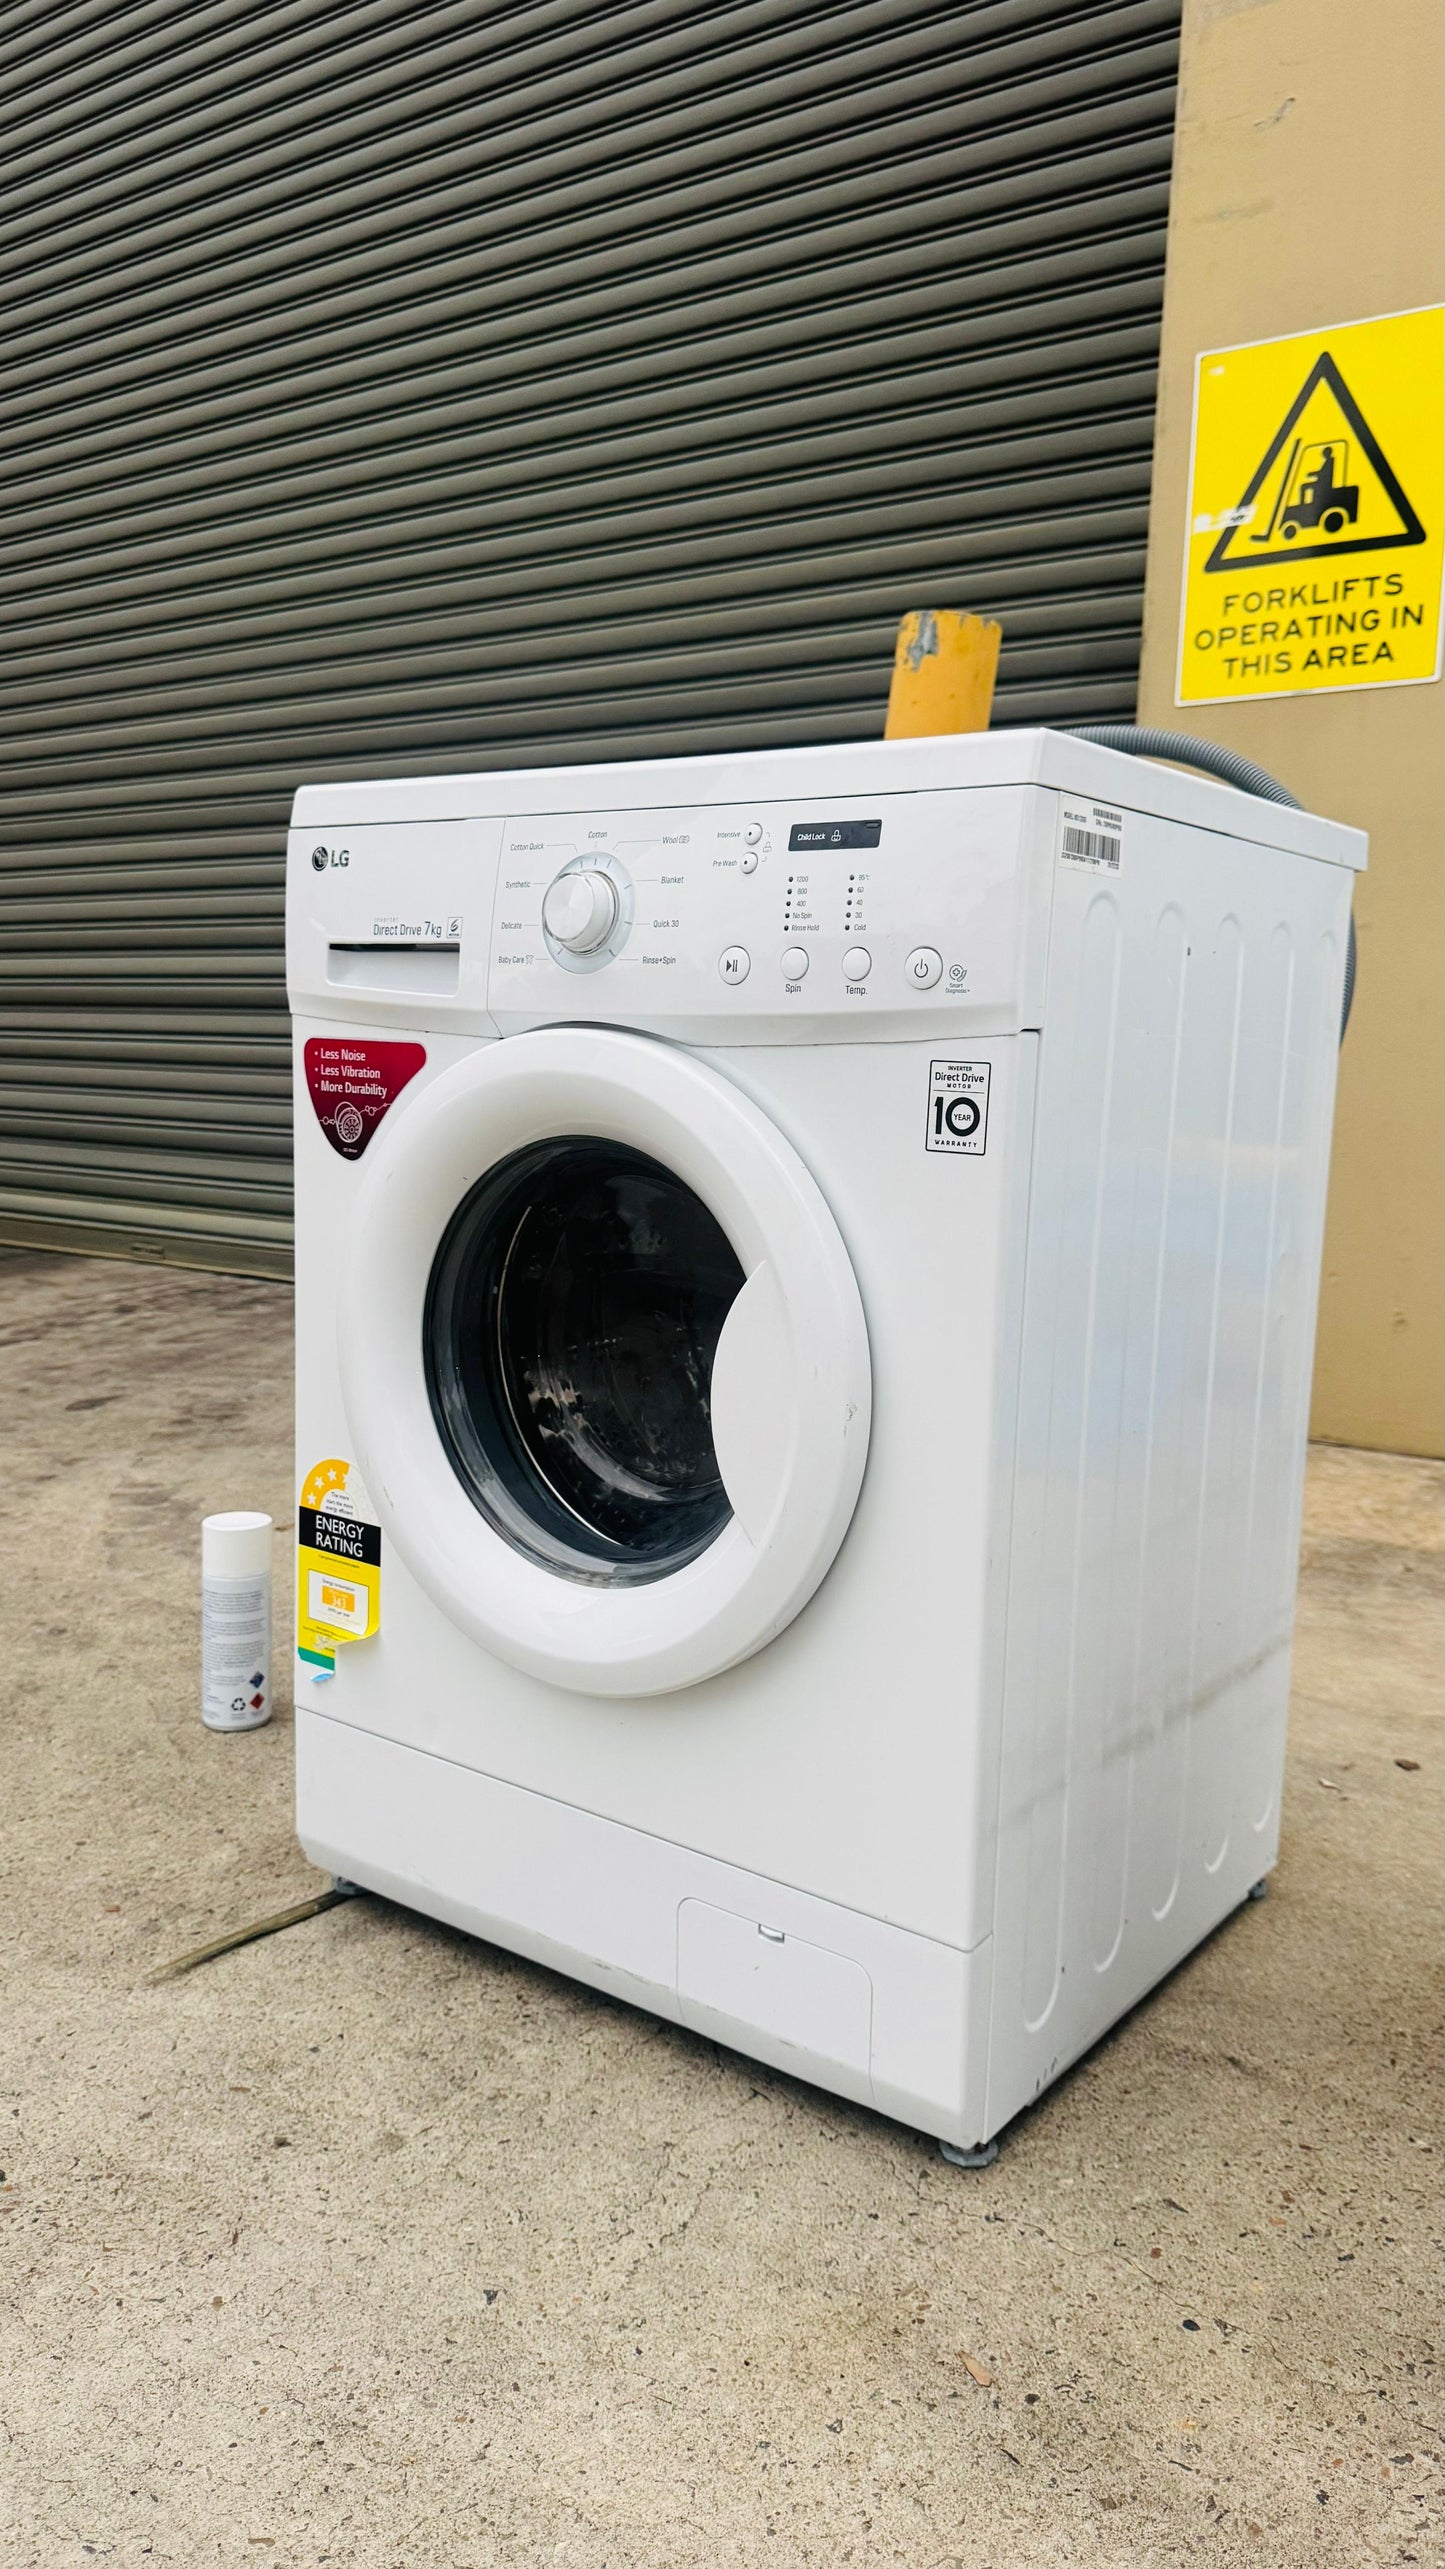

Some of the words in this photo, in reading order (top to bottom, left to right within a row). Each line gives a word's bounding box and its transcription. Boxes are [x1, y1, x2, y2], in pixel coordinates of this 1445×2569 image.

[1222, 573, 1404, 618] FORKLIFTS
[1194, 608, 1381, 652] OPERATING
[1391, 603, 1425, 629] IN
[1224, 650, 1293, 681] THIS
[1302, 640, 1395, 672] AREA
[662, 835, 679, 844] Wool
[510, 843, 528, 851] Cotton
[529, 842, 544, 850] Quick
[330, 849, 350, 868] LG
[505, 881, 531, 889] Synthetic
[660, 875, 685, 883] Blanket
[801, 911, 812, 920] Spin
[501, 922, 522, 930] Delicate
[653, 919, 671, 927] Quick
[671, 919, 679, 927] 30
[373, 923, 399, 936] Direct
[400, 923, 422, 936] Drive
[424, 920, 443, 939] 7kg
[498, 956, 511, 964] Baby
[512, 956, 525, 964] Care
[642, 956, 677, 965] Rinse+Spin
[785, 983, 802, 994] Spin
[846, 984, 869, 996] Temp.
[320, 1048, 340, 1059] Less
[341, 1049, 366, 1061] Noise
[320, 1064, 340, 1076] Less
[341, 1066, 381, 1079] Vibration
[935, 1071, 960, 1082] Direct
[961, 1073, 985, 1083] Drive
[320, 1081, 343, 1092] More
[344, 1082, 388, 1099] Durability
[934, 1096, 981, 1137] 10
[954, 1113, 972, 1122] YEAR
[934, 1139, 978, 1148] WARRANTY
[315, 1514, 365, 1540] ENERGY
[315, 1531, 363, 1558] RATING
